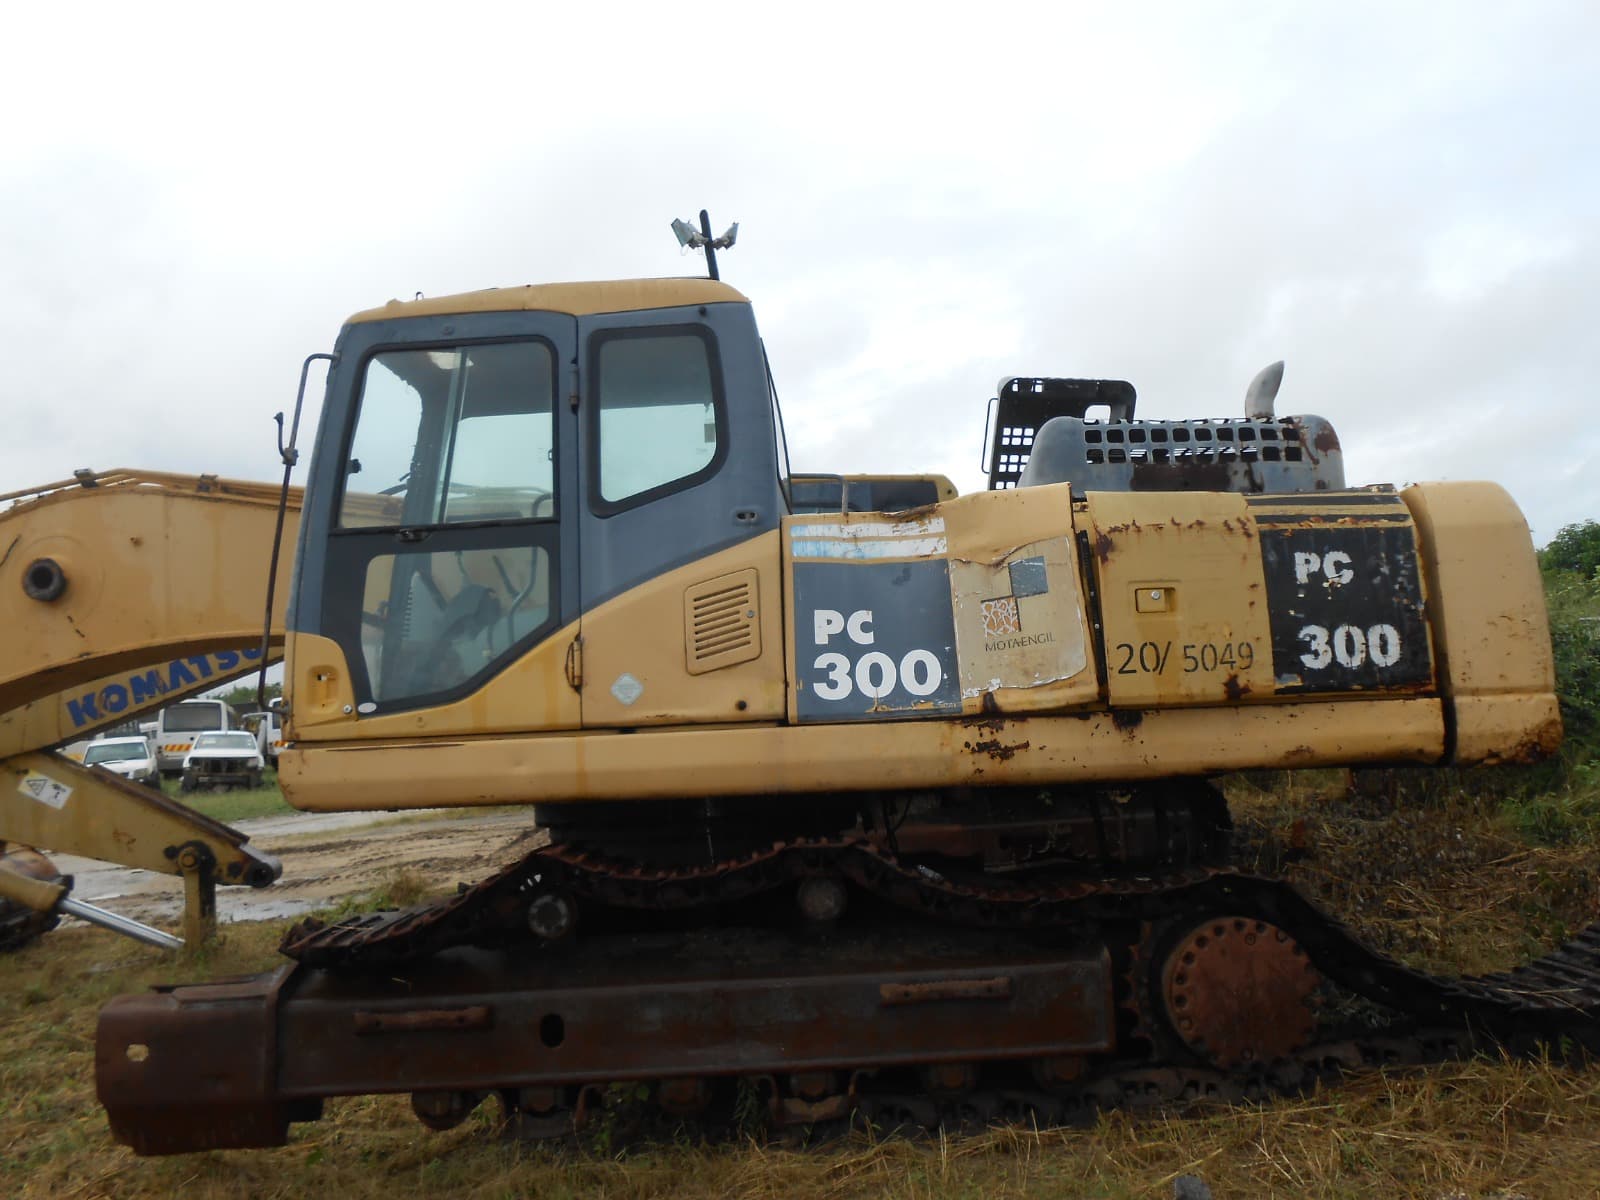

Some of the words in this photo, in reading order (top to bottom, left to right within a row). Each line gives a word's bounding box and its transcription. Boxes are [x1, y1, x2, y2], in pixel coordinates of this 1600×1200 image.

[1294, 551, 1354, 585] PC
[813, 609, 874, 645] PC
[1183, 641, 1254, 673] 5049
[1299, 623, 1402, 670] 300
[813, 649, 942, 700] 300
